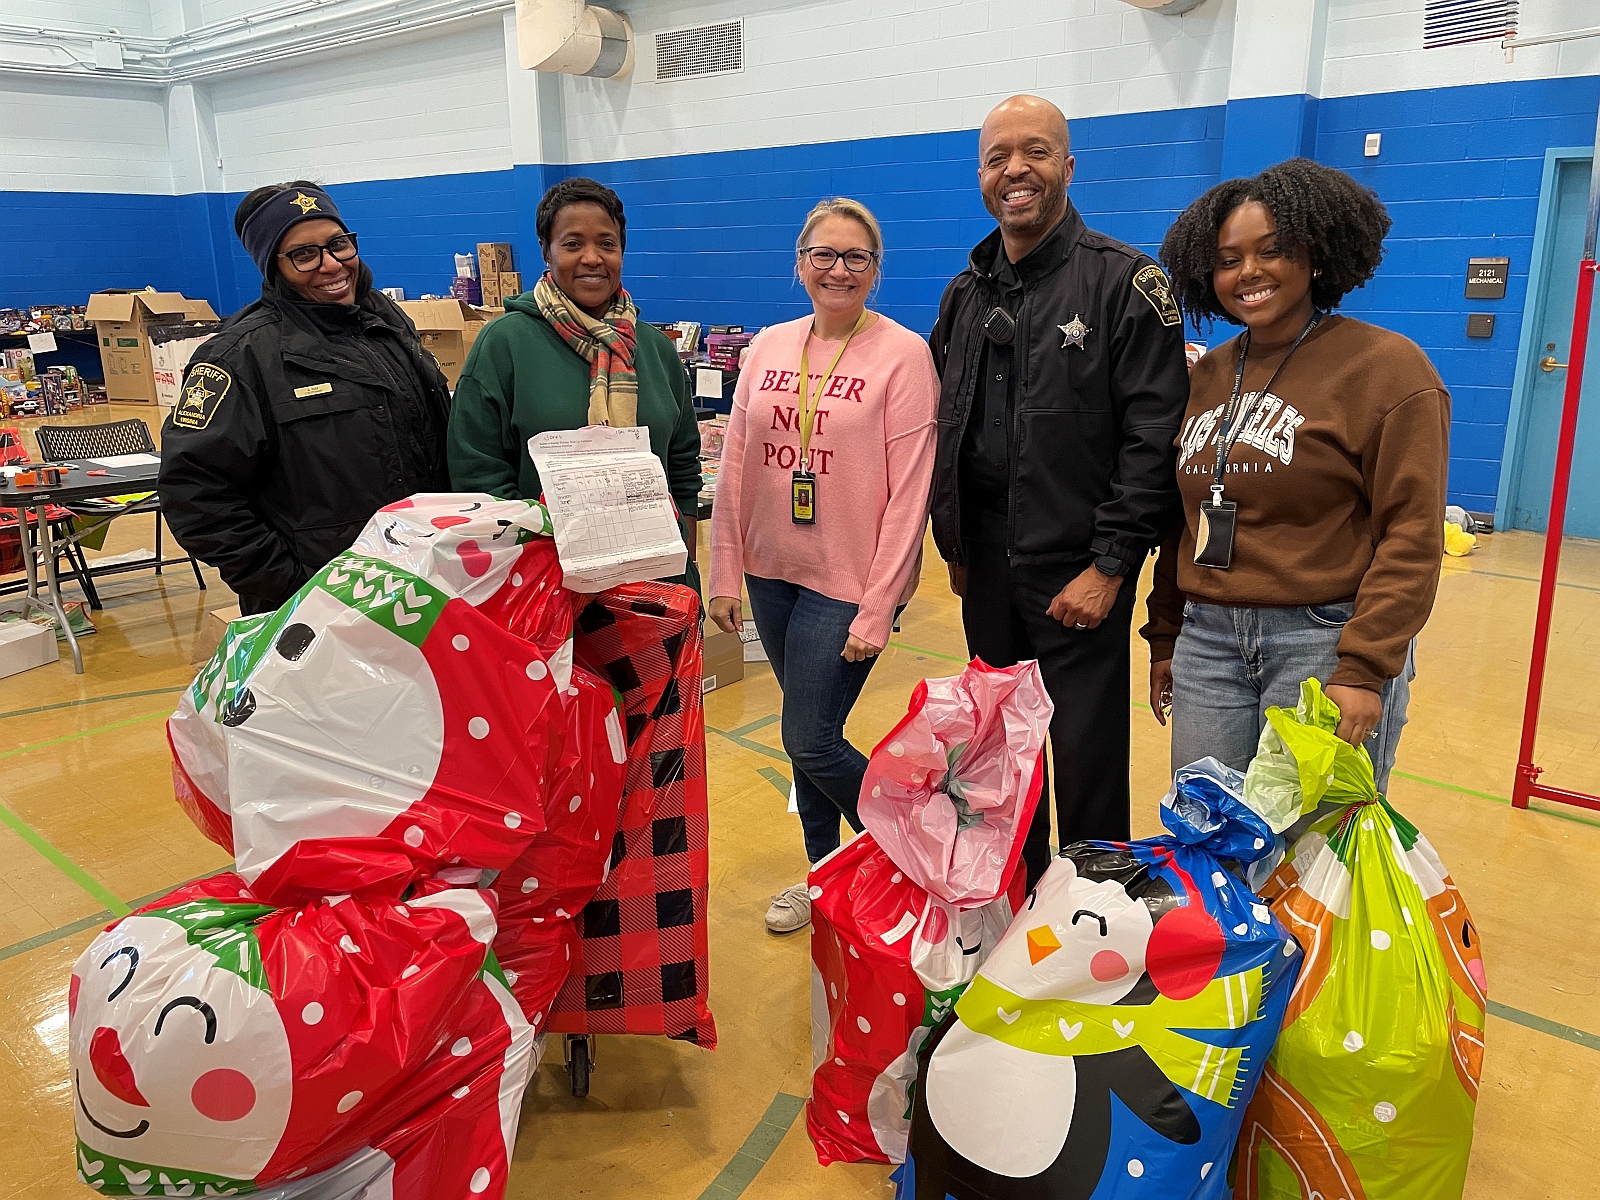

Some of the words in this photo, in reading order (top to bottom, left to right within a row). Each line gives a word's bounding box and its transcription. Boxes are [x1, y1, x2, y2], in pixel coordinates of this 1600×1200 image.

[1478, 269, 1495, 277] 2121
[190, 366, 226, 382] SHERIFF
[1179, 403, 1226, 471] LOS
[762, 442, 834, 475] POUT
[1185, 462, 1273, 475] CALIORNIA
